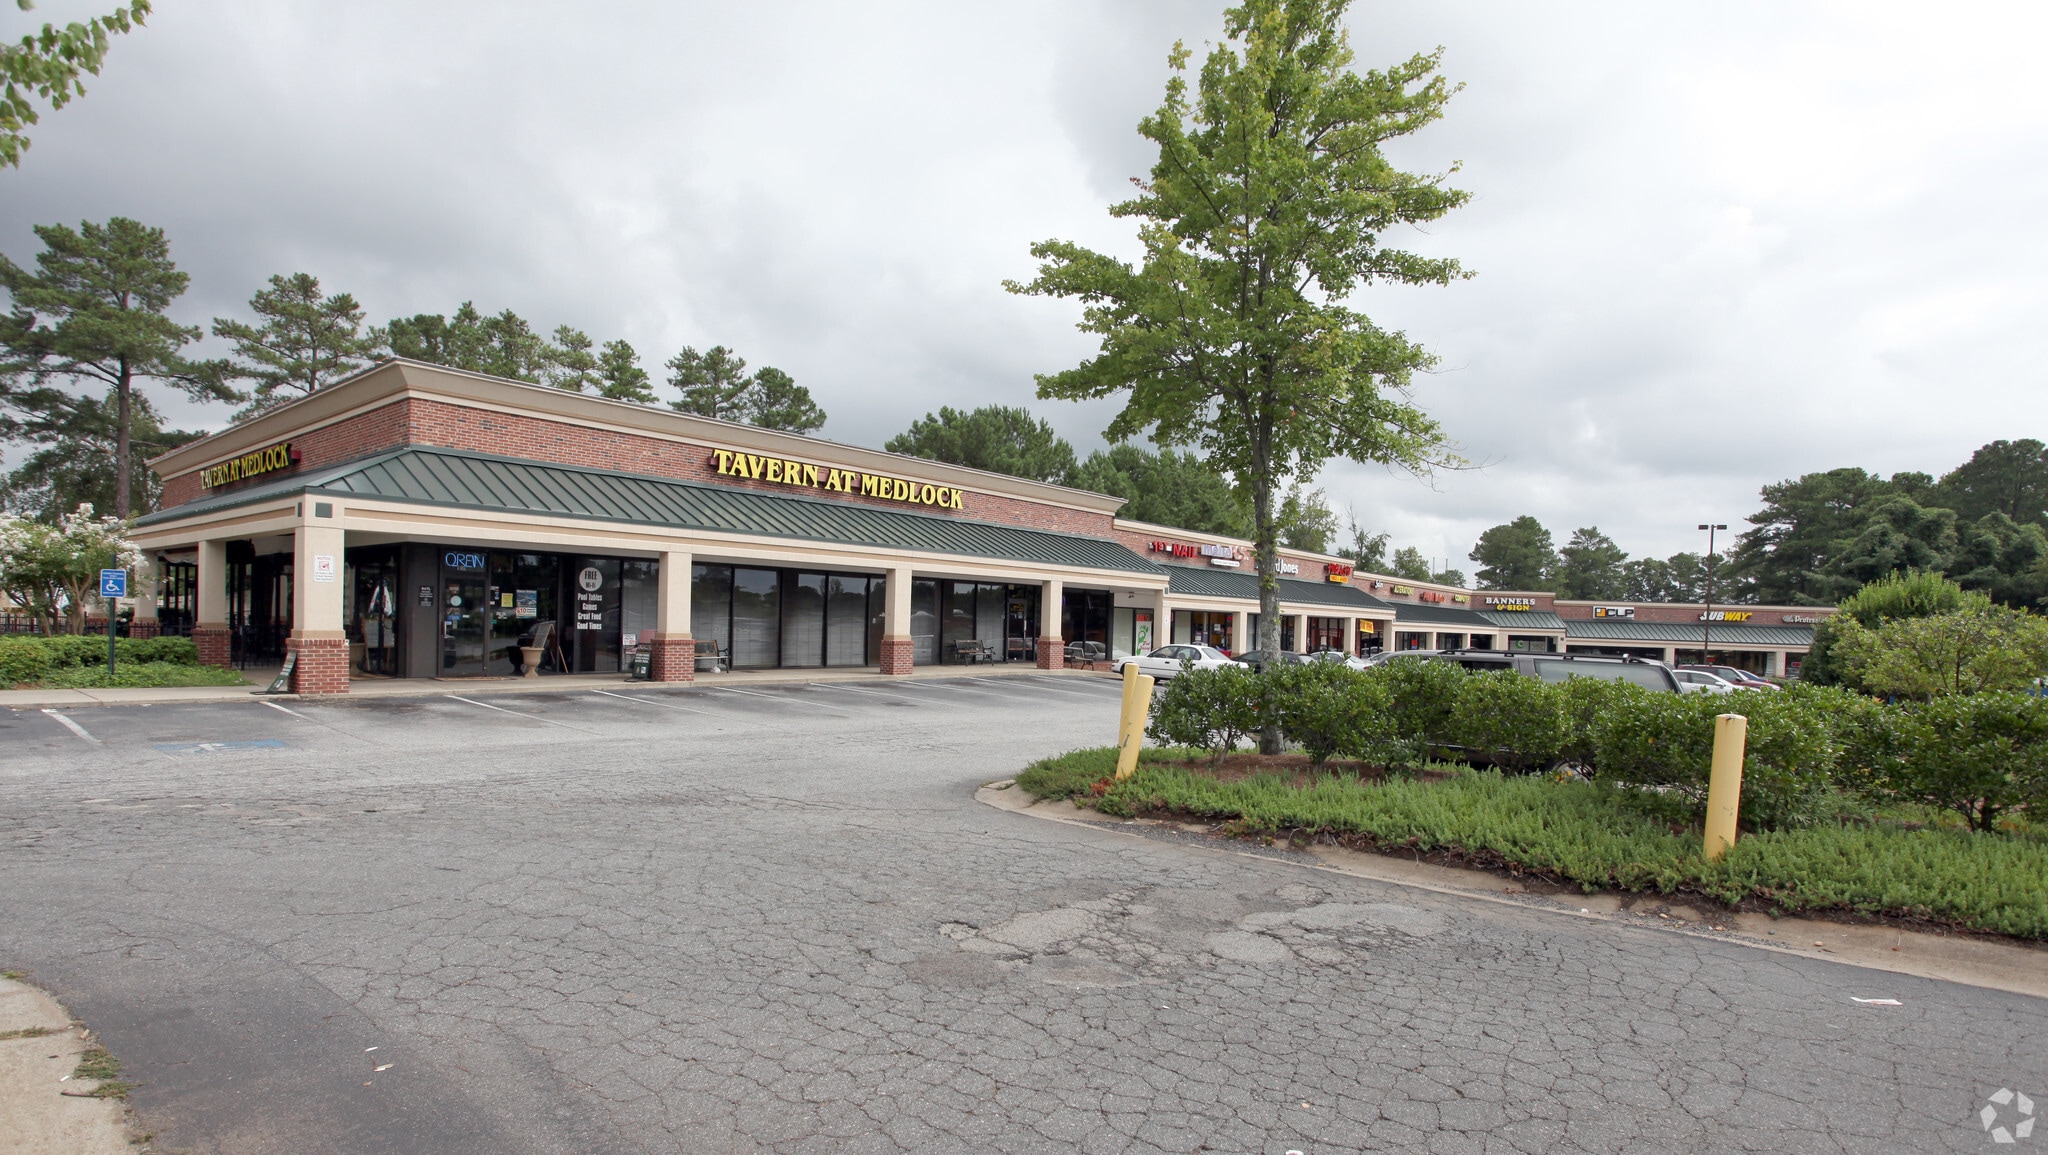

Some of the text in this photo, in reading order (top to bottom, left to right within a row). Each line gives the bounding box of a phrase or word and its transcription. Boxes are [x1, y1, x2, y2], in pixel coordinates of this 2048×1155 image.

[200, 443, 289, 490] TAVERN AT MEDLOCK
[714, 448, 964, 511] TAVERN AT MEDLOCK
[1281, 558, 1299, 574] Jones
[585, 571, 597, 580] FREE
[1485, 597, 1535, 606] BANNERS
[583, 603, 597, 611] Games
[1699, 610, 1753, 622] SUBWAY
[577, 621, 602, 630] Good Times
